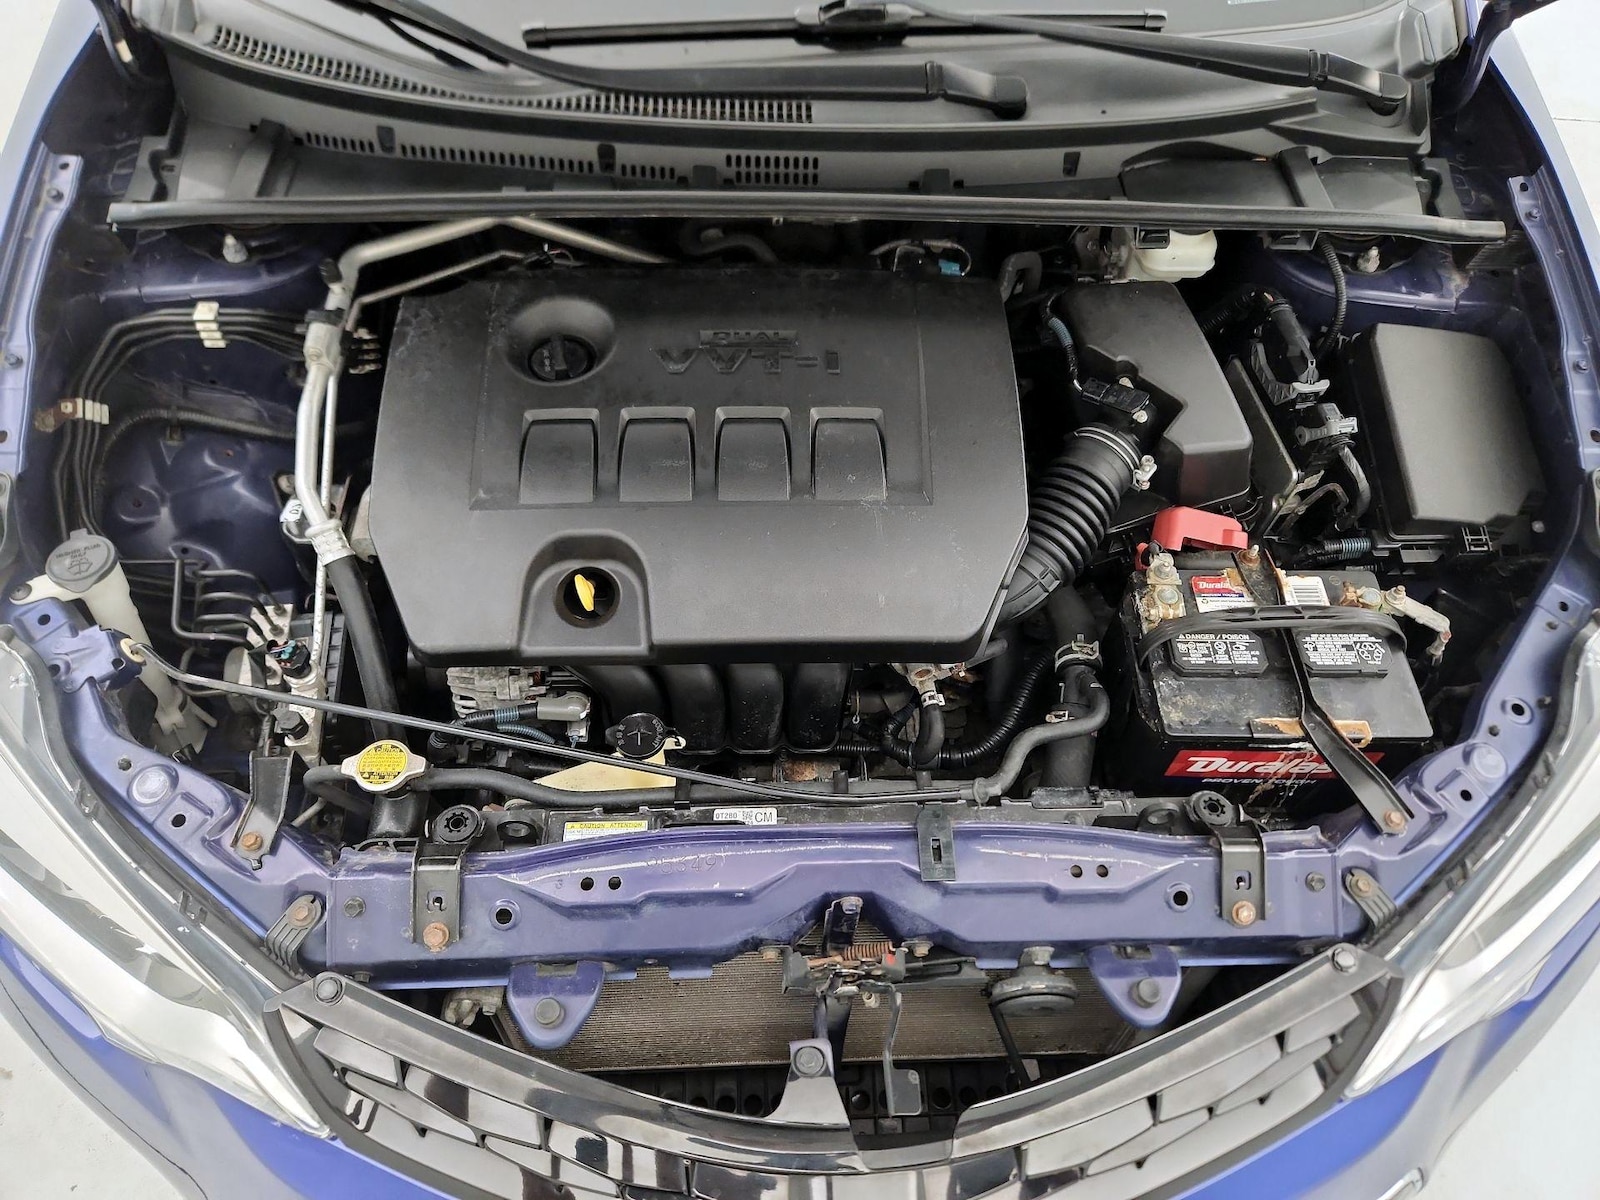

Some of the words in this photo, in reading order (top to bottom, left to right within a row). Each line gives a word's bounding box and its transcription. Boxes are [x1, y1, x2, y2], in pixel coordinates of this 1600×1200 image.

[713, 331, 790, 341] DUAL
[1187, 757, 1333, 773] Duralas
[754, 811, 773, 823] CM
